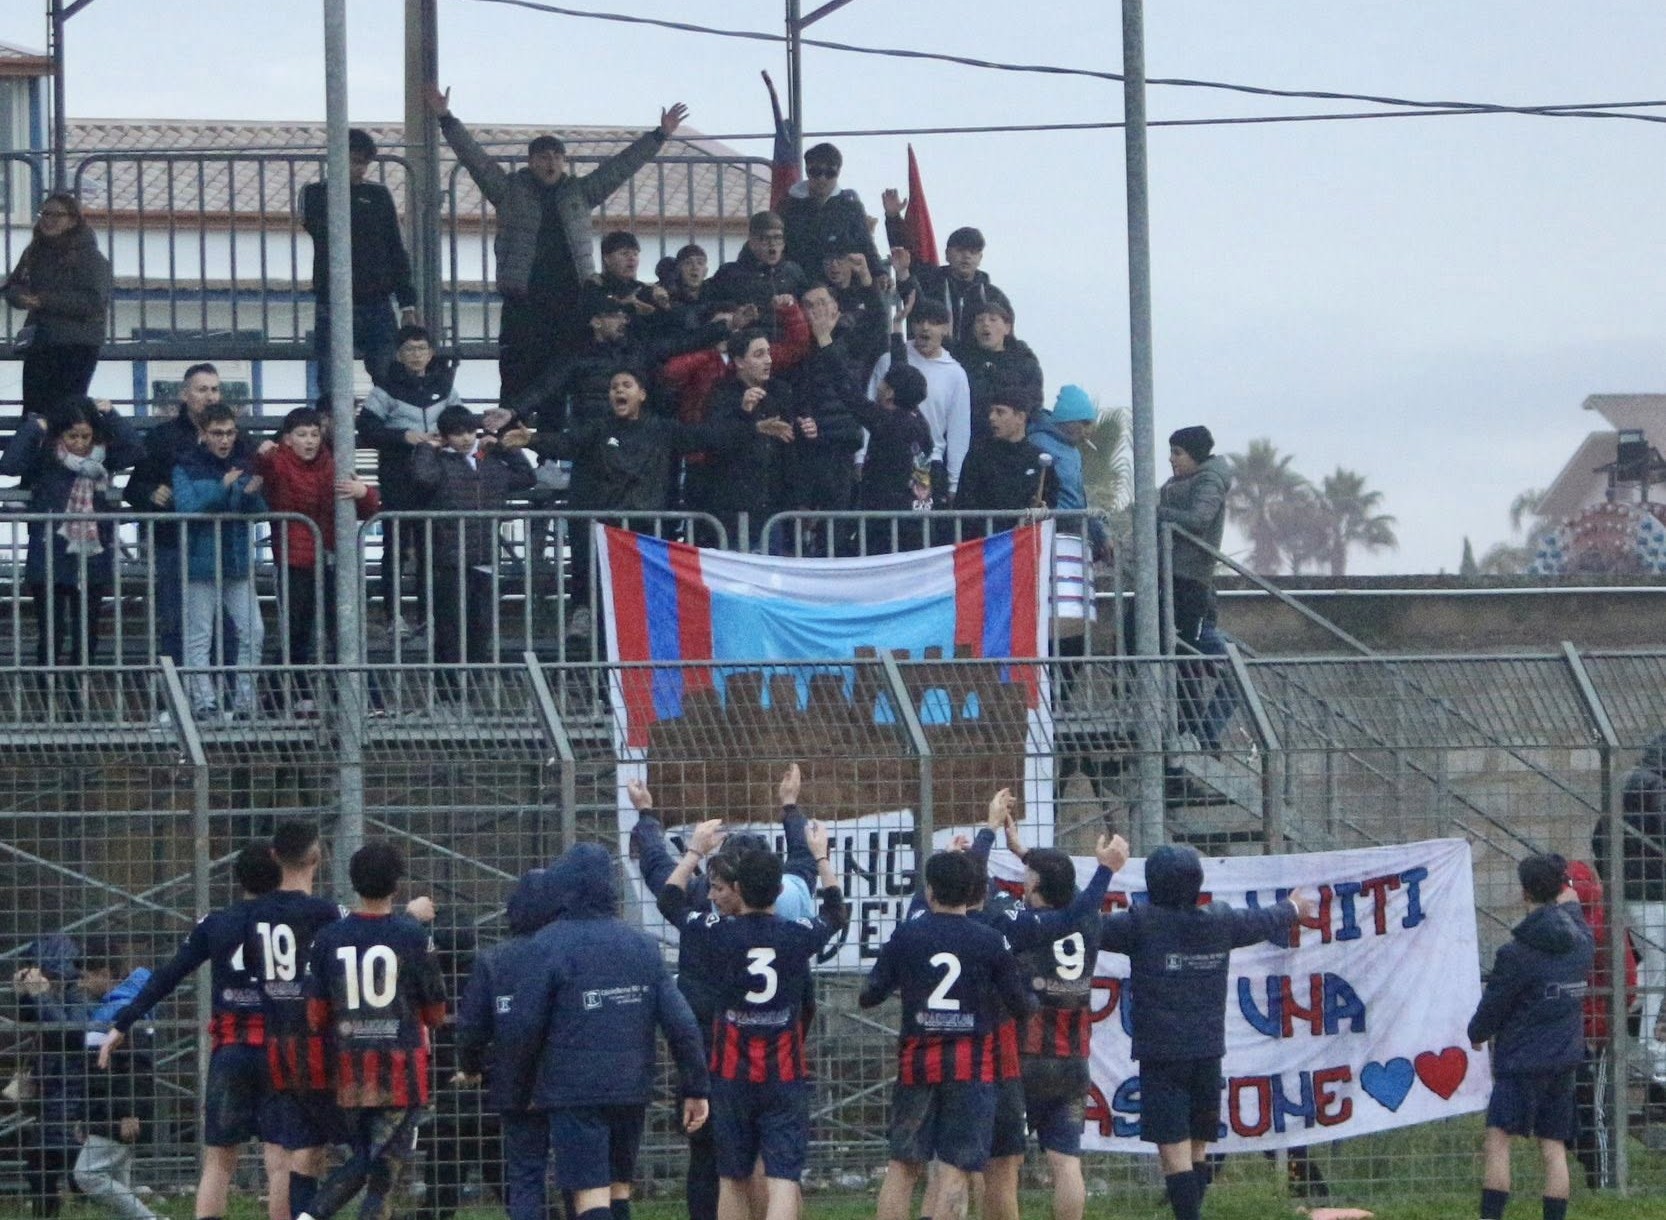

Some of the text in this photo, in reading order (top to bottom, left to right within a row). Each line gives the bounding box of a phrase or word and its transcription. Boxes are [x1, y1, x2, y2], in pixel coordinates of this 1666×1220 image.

[256, 922, 297, 981] 19
[336, 945, 398, 1010] 10
[745, 947, 778, 1004] 3
[1053, 931, 1085, 980] 9
[926, 952, 962, 1011] 2
